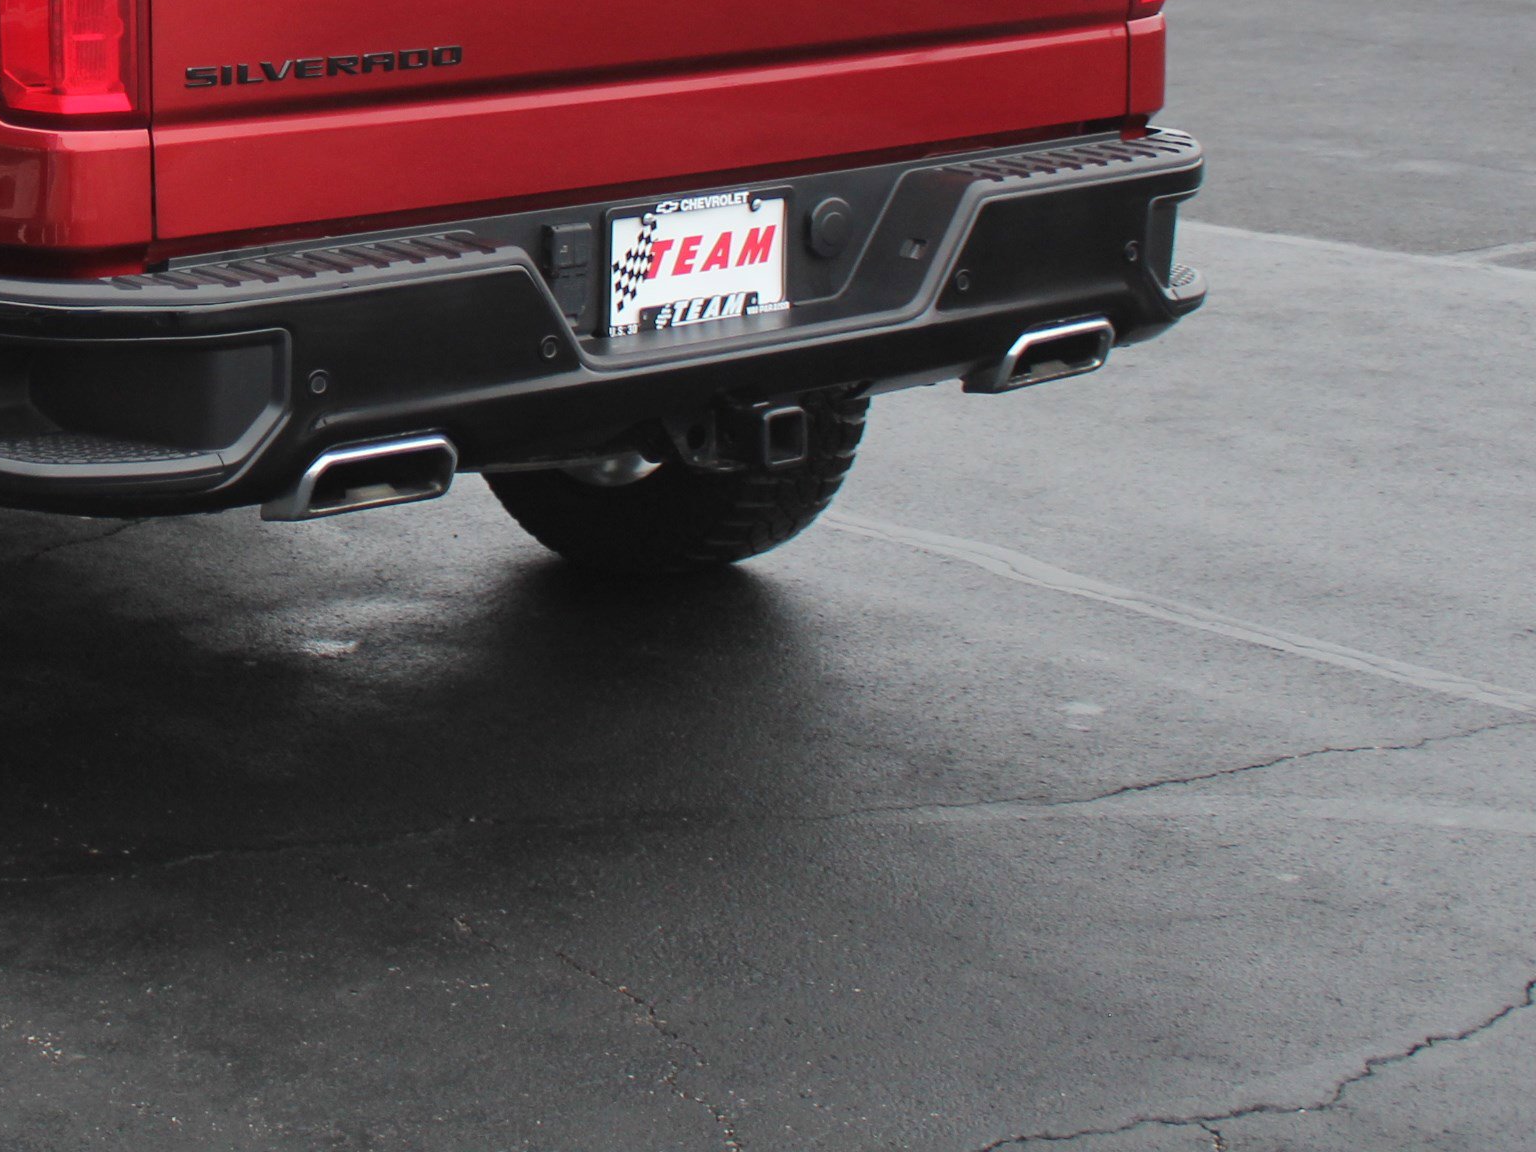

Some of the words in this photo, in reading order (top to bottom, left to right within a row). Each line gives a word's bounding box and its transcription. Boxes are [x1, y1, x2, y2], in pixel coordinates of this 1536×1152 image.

[184, 45, 462, 88] SILVERADO
[680, 191, 750, 211] CHEVROLET
[644, 224, 777, 280] TEAM
[671, 292, 747, 324] TEAM
